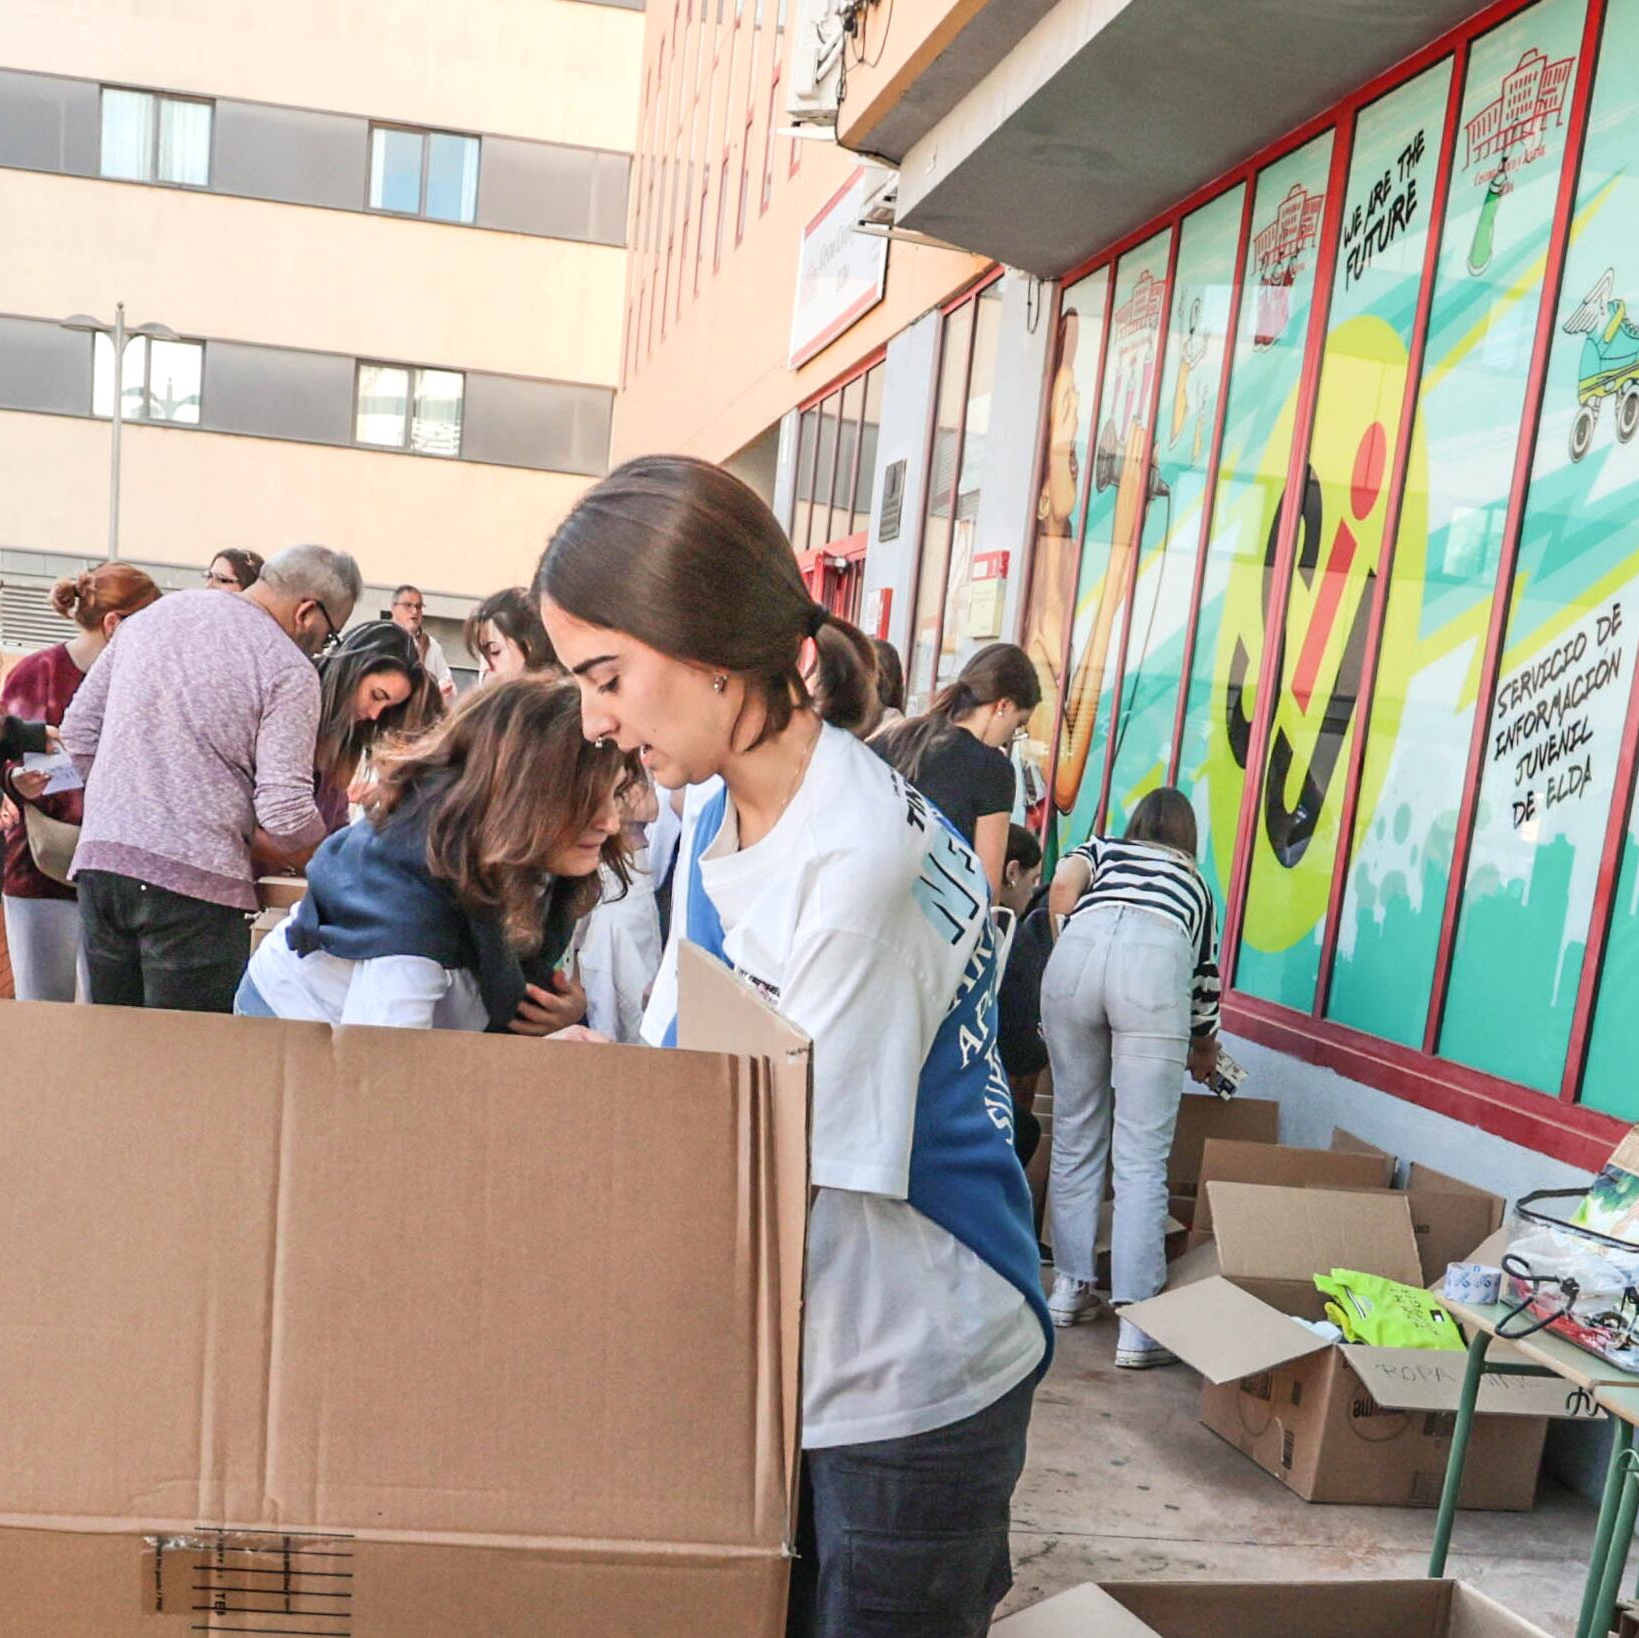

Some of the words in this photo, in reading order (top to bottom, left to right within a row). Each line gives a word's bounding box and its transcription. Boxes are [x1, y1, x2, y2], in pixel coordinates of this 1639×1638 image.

[1344, 204, 1362, 249] WE
[1363, 169, 1392, 234] ARE
[1398, 129, 1425, 184] THE
[1346, 178, 1418, 292] FUTURE
[1494, 646, 1622, 761] INFORMACIÓN
[1498, 631, 1587, 718] SERVICIO
[1597, 602, 1623, 646] DE
[1512, 790, 1536, 830] DE
[1546, 753, 1592, 809] ELDA
[1514, 715, 1594, 786] JUVENIL
